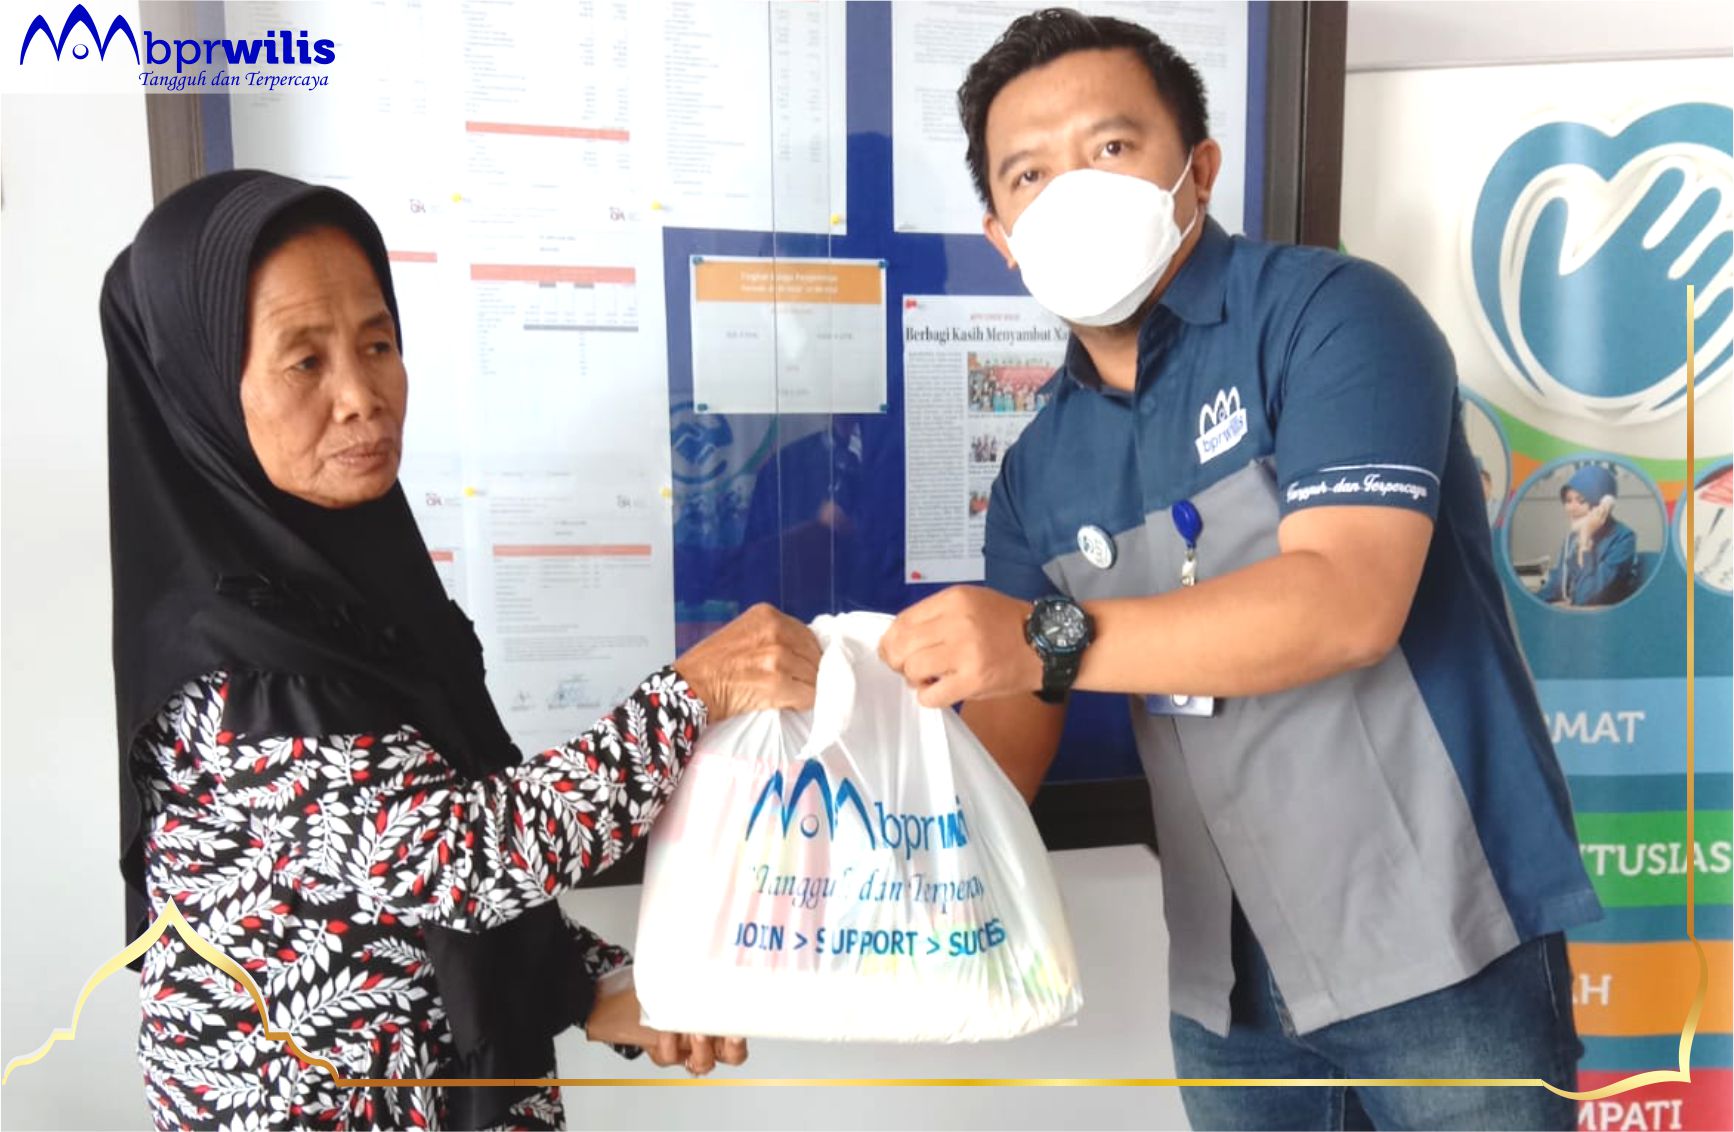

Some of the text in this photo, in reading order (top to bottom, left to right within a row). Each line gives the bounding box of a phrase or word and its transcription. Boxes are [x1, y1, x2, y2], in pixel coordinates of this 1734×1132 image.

[905, 326, 950, 345] Berbagi
[952, 327, 984, 342] Kasih
[1331, 475, 1361, 493] dan
[1545, 711, 1646, 744] MAT
[1579, 840, 1732, 877] TUSIAS
[734, 921, 784, 951] JOIN
[816, 927, 919, 957] SUPPORT
